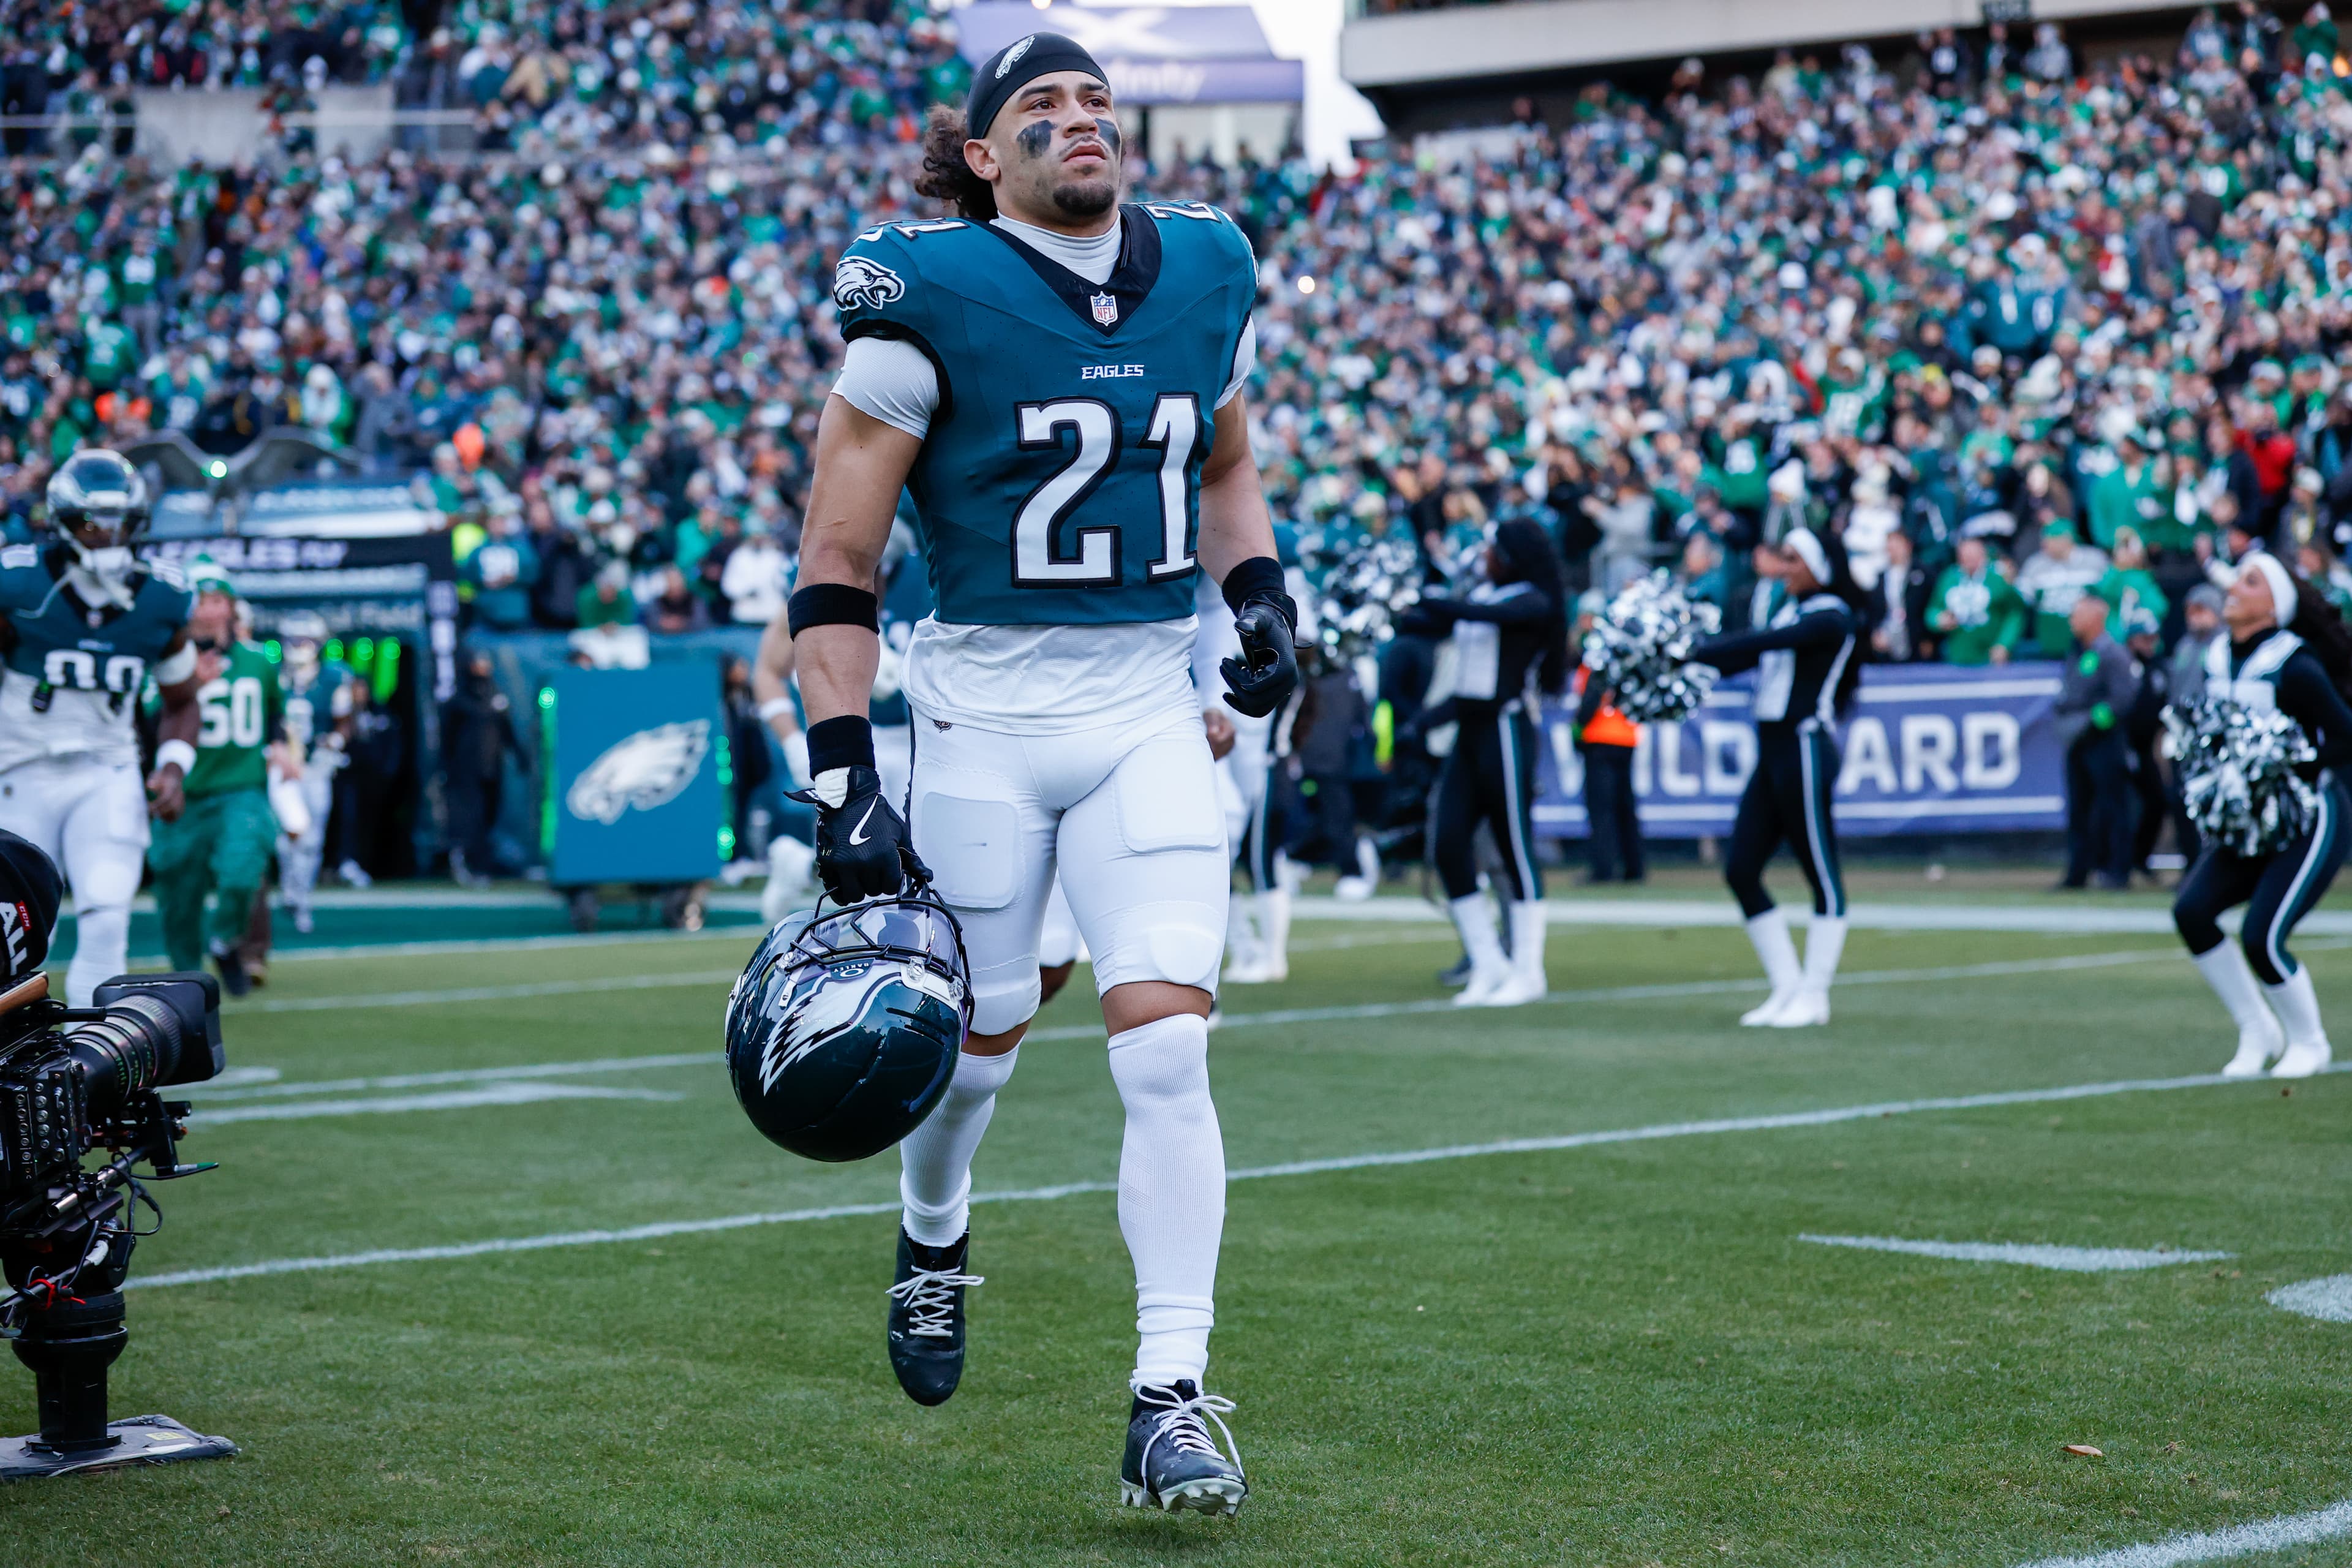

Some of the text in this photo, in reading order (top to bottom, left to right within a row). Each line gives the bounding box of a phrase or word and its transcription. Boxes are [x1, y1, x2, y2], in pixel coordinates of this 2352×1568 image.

[1096, 307, 1114, 320] NFL
[1082, 364, 1145, 380] EAGLES
[1012, 393, 1202, 588] 21
[196, 676, 263, 748] 50
[1837, 712, 2021, 794] ARD
[834, 962, 869, 973] OAKLEY
